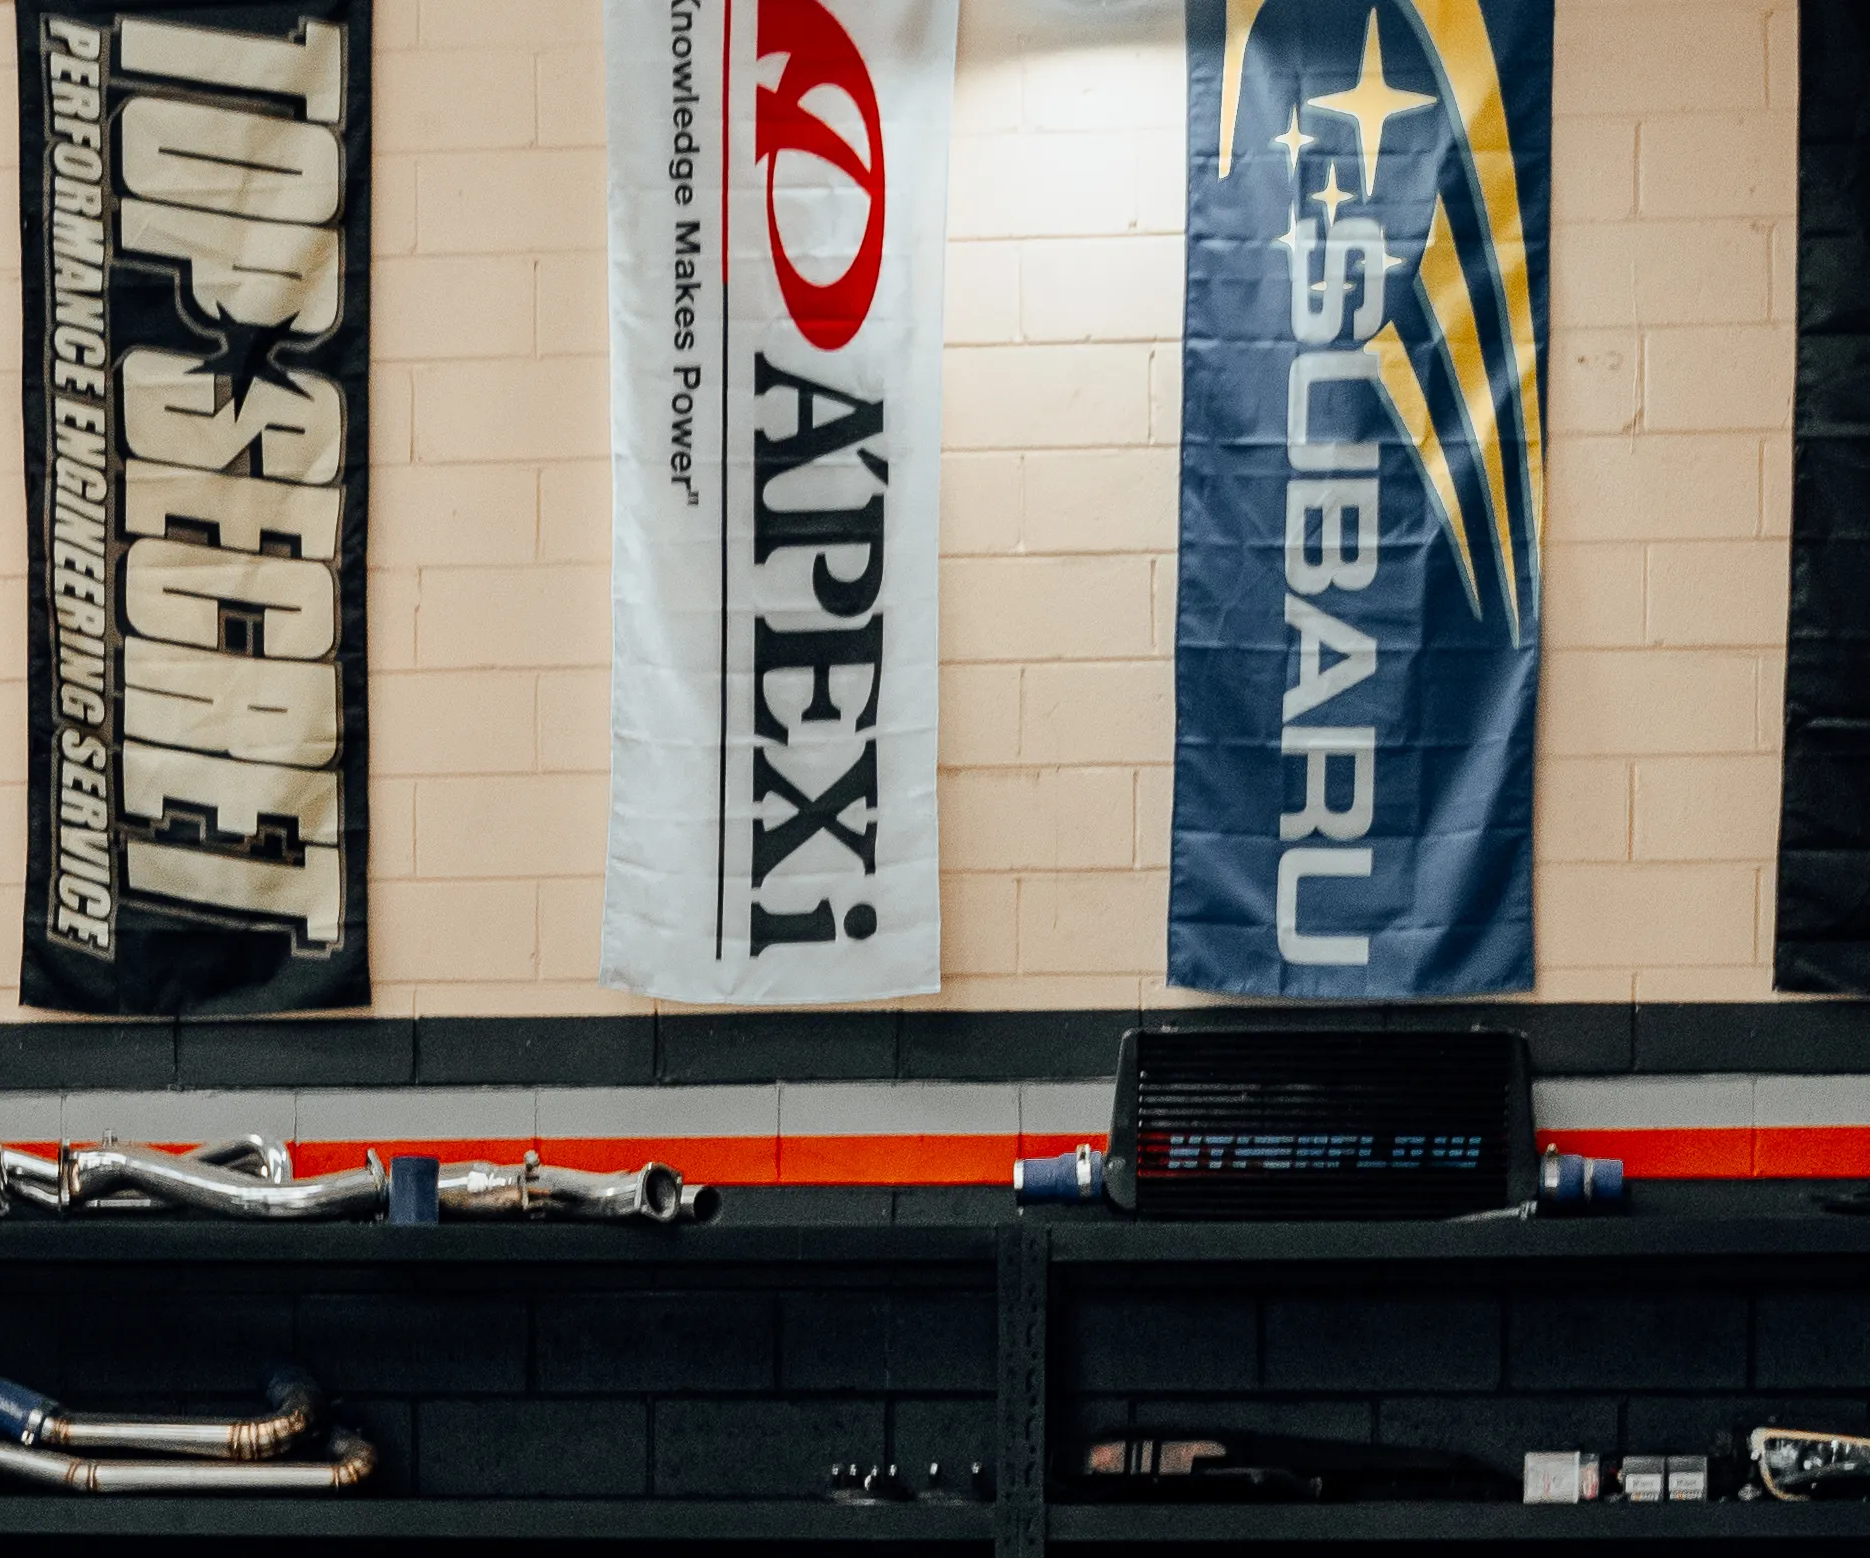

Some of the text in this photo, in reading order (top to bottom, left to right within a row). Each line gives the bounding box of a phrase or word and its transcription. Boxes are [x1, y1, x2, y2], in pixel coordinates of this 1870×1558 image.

[48, 20, 114, 950] PERFORMANCE ENGINEERING SERVICE
[118, 18, 344, 944] TOP SECRET
[673, 220, 702, 352] Makes
[1276, 216, 1390, 967] SUBARU
